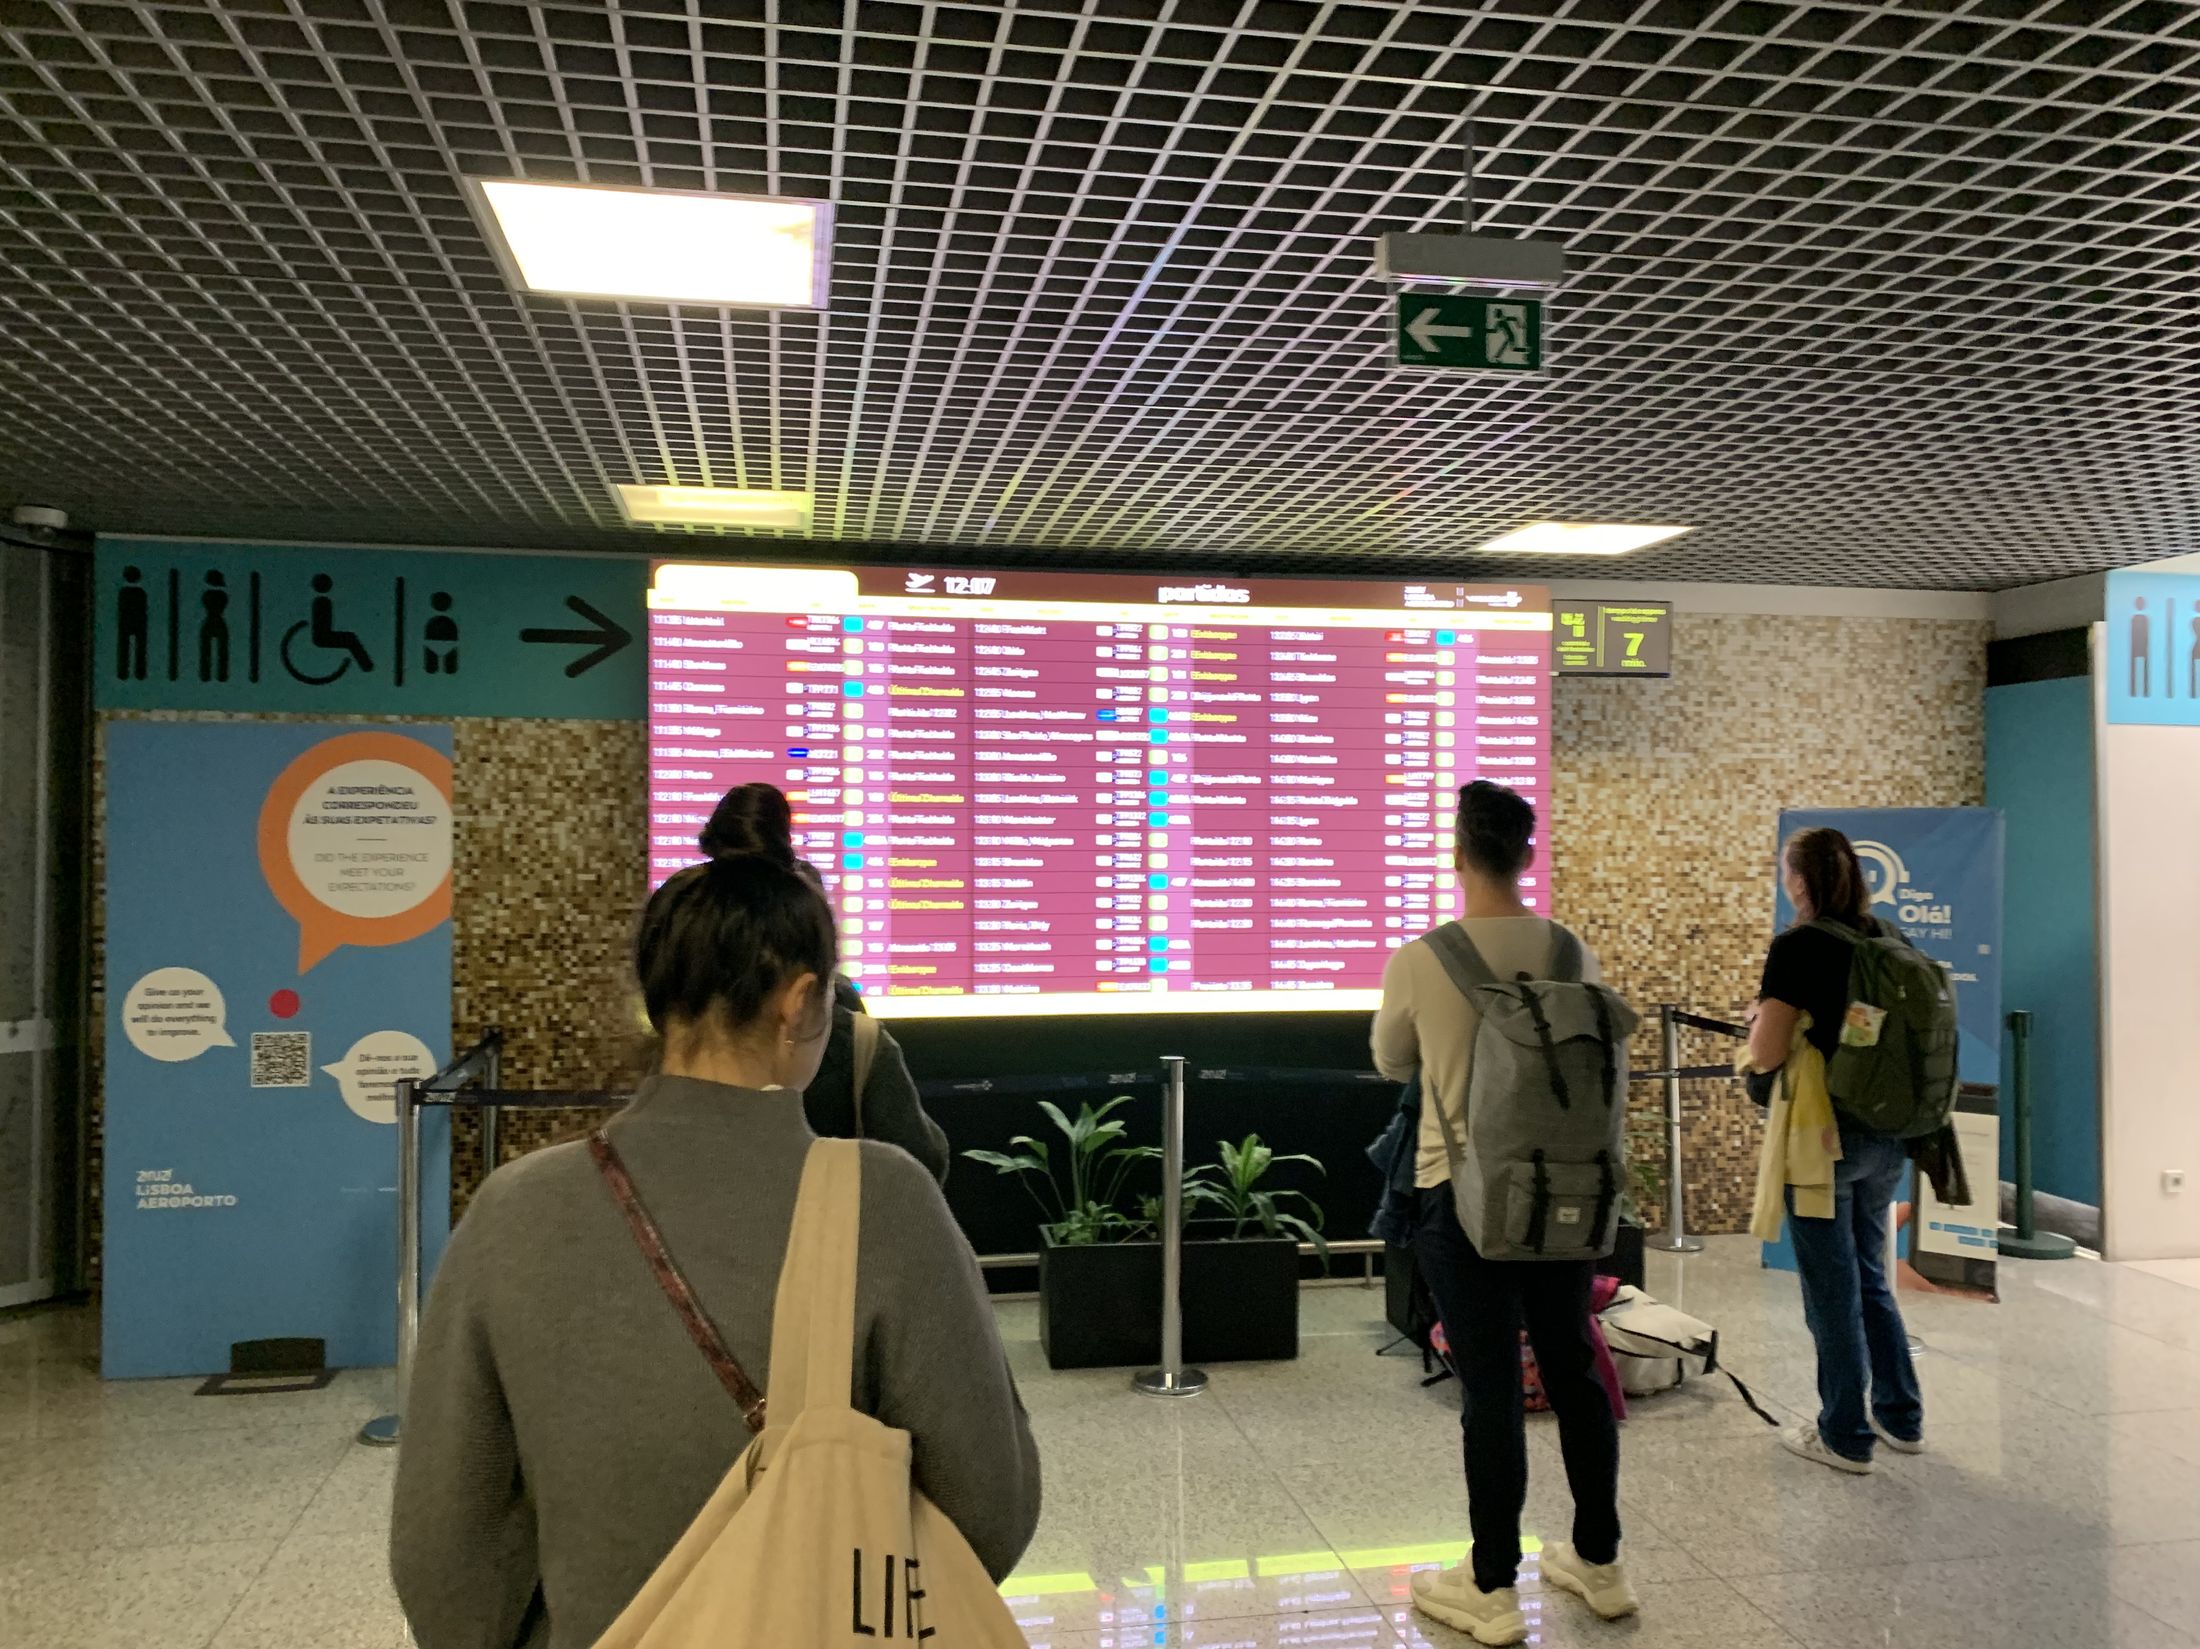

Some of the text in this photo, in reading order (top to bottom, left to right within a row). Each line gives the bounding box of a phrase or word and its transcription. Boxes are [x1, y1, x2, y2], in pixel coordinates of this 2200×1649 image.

[1158, 584, 1250, 603] partidas
[1624, 632, 1645, 657] 7
[327, 784, 415, 795] A EXPERIÊNCIA
[337, 853, 358, 862] THE
[361, 853, 430, 862] EXPERIENCE
[340, 868, 405, 877] MEET YOUR
[1898, 904, 1952, 924] Olá!
[182, 989, 205, 998] your
[165, 1014, 218, 1024] everything
[137, 1195, 237, 1209] AEROPORTO
